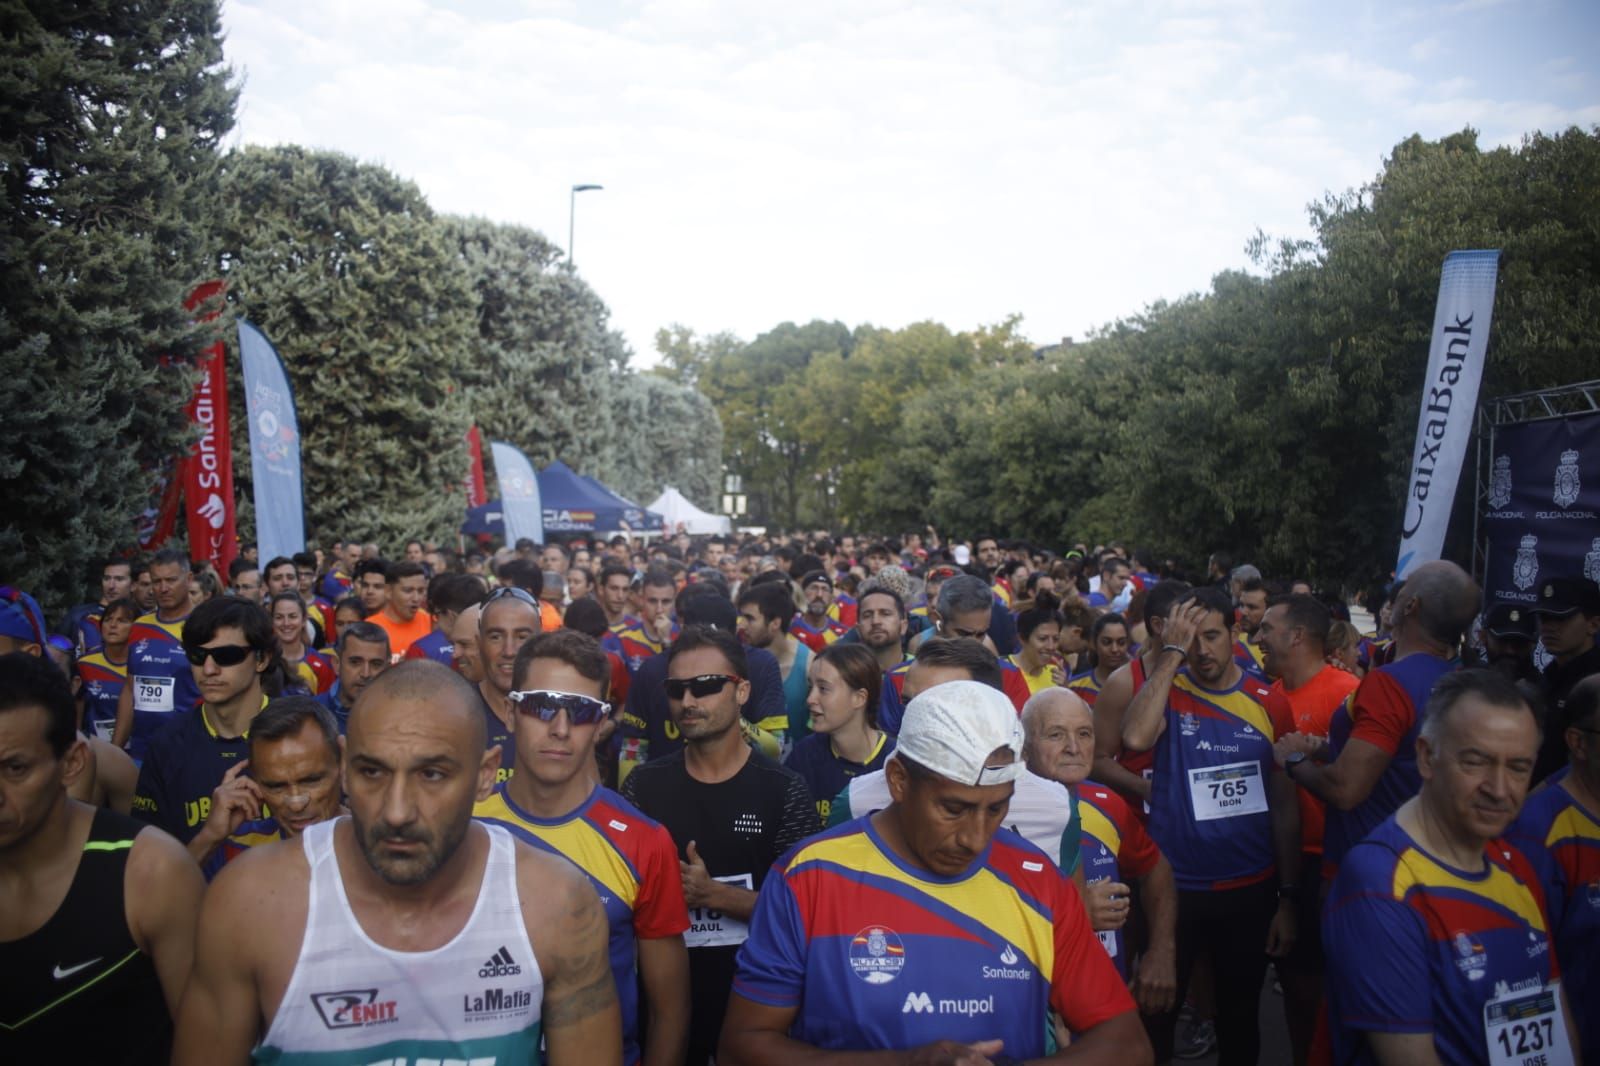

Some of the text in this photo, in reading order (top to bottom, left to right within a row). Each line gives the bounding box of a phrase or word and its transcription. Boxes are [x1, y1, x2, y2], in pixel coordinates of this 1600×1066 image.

[1402, 311, 1473, 539] CaixaBank
[140, 686, 163, 697] 790
[1213, 743, 1239, 755] mupol
[1208, 780, 1248, 799] 765
[1219, 798, 1242, 807] IBON
[691, 923, 723, 933] RAUL
[479, 965, 522, 978] adidas
[939, 995, 994, 1017] mupol
[1498, 1017, 1553, 1058] 1237
